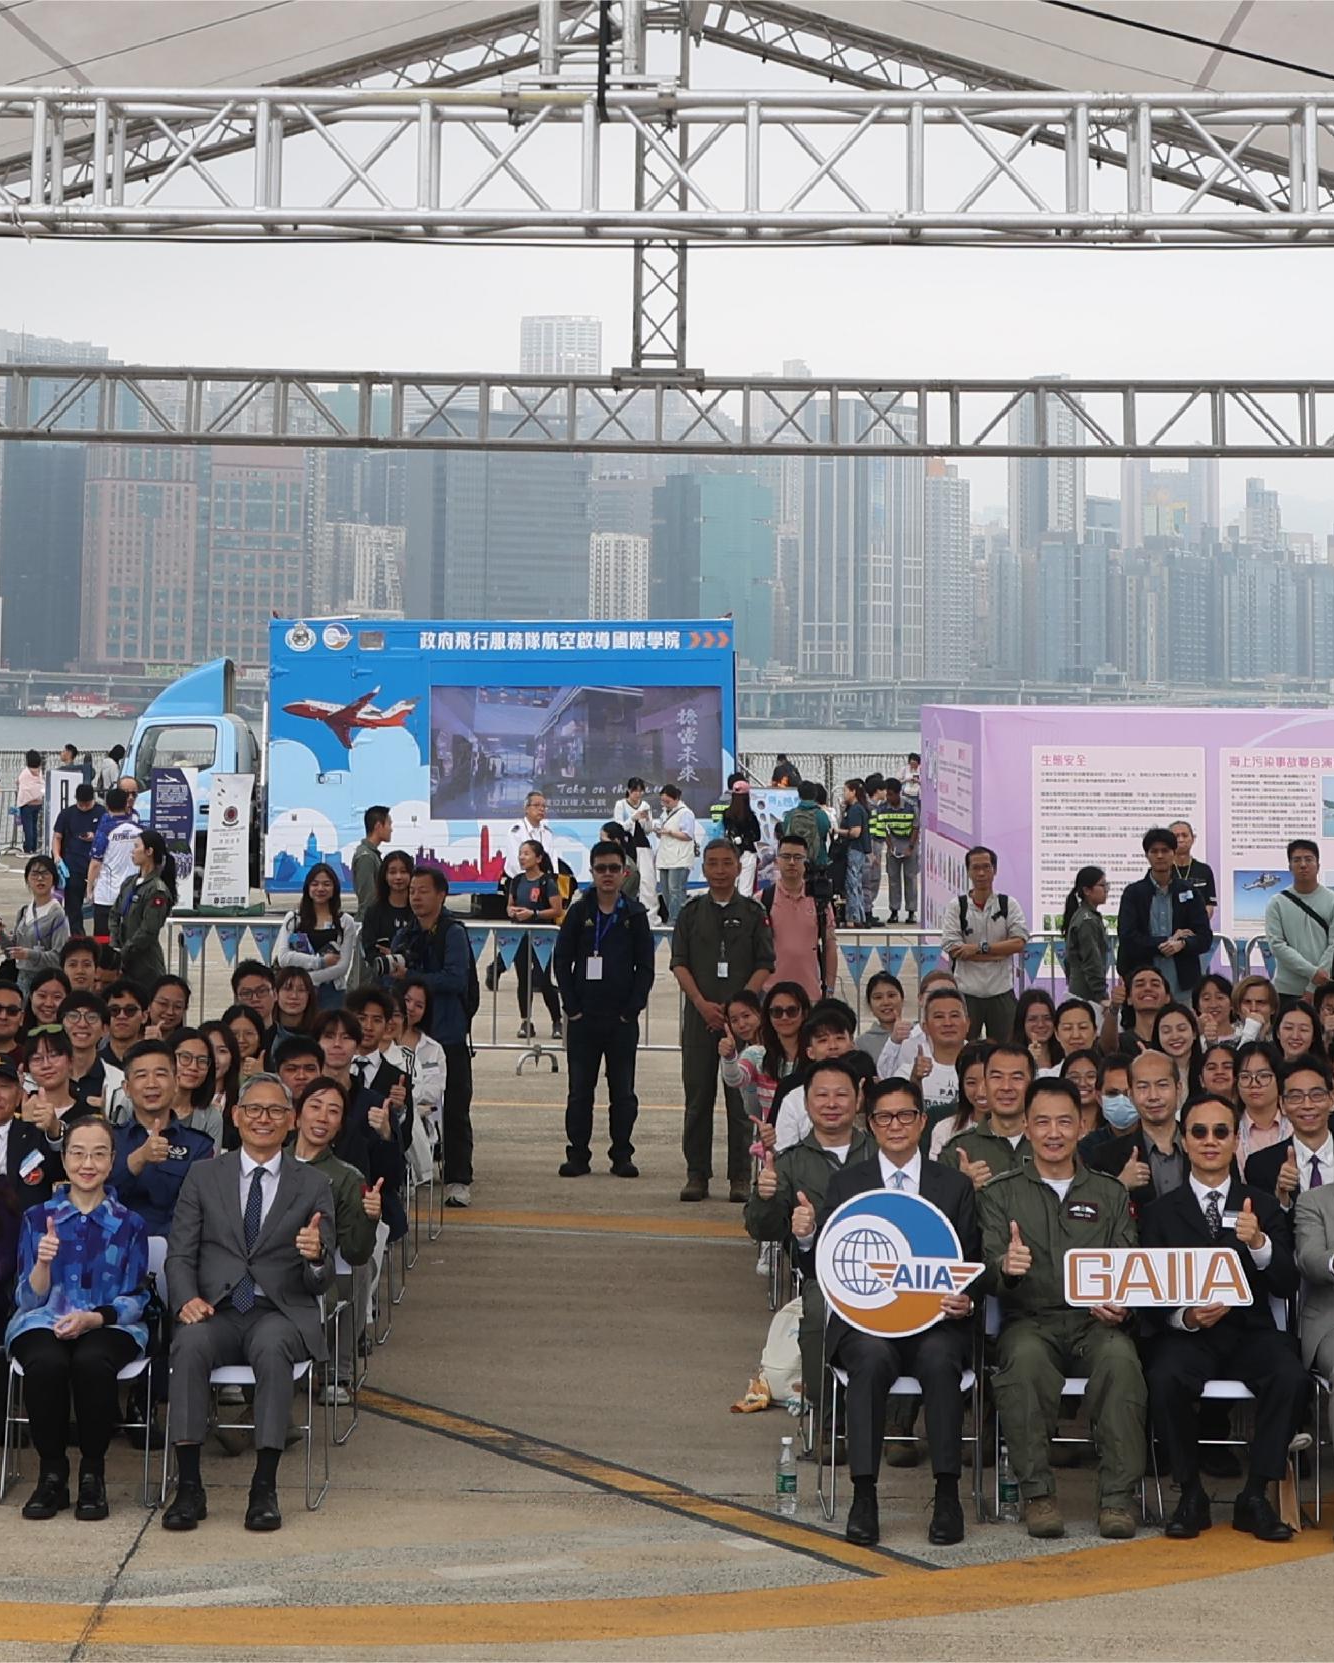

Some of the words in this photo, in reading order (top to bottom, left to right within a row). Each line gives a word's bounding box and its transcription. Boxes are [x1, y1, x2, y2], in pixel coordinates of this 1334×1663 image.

[1040, 754, 1087, 767] 生態安全
[557, 784, 586, 794] Take
[592, 786, 606, 794] on
[892, 1263, 954, 1291] AIIA
[1069, 1251, 1249, 1302] GAIIA
